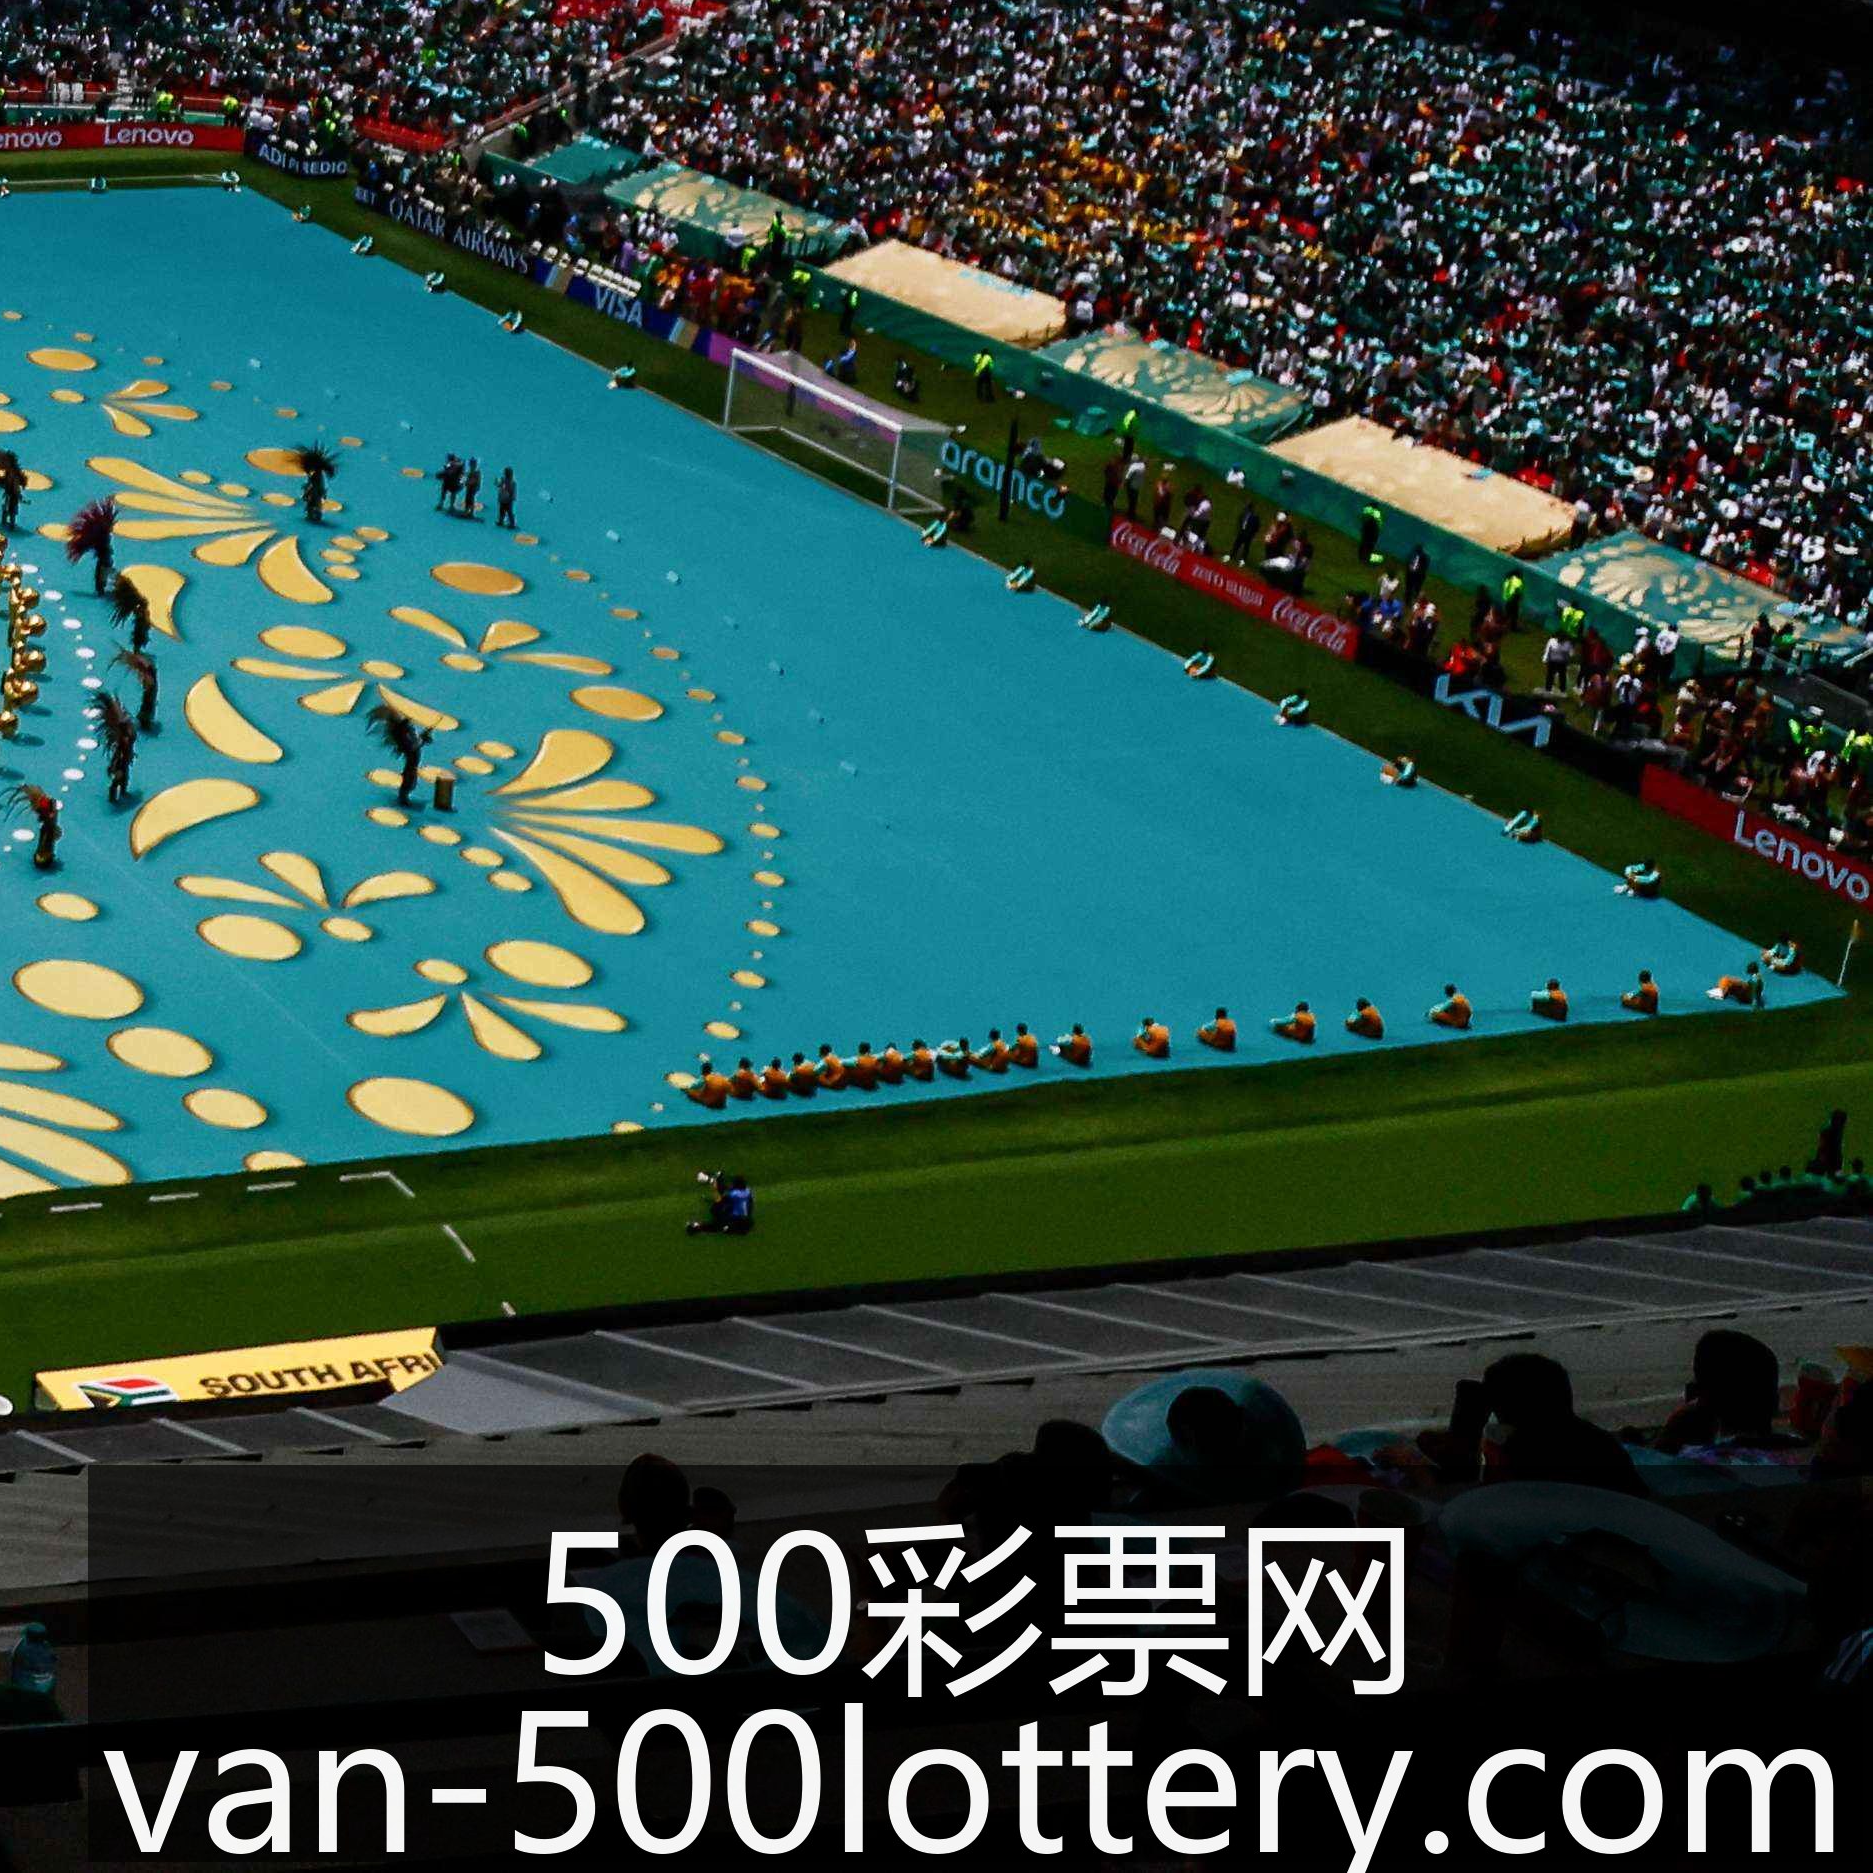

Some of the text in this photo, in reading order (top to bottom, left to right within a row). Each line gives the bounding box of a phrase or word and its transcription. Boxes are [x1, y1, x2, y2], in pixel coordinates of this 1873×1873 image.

[102, 123, 196, 148] Lenovo
[388, 194, 446, 238] QATAR
[453, 222, 531, 276] AIRWAYS
[593, 282, 644, 330] VISA
[941, 438, 1066, 521] aramco
[1434, 672, 1553, 749] KIA
[1733, 809, 1871, 894] Lenovo
[199, 1362, 345, 1398] SOUTH
